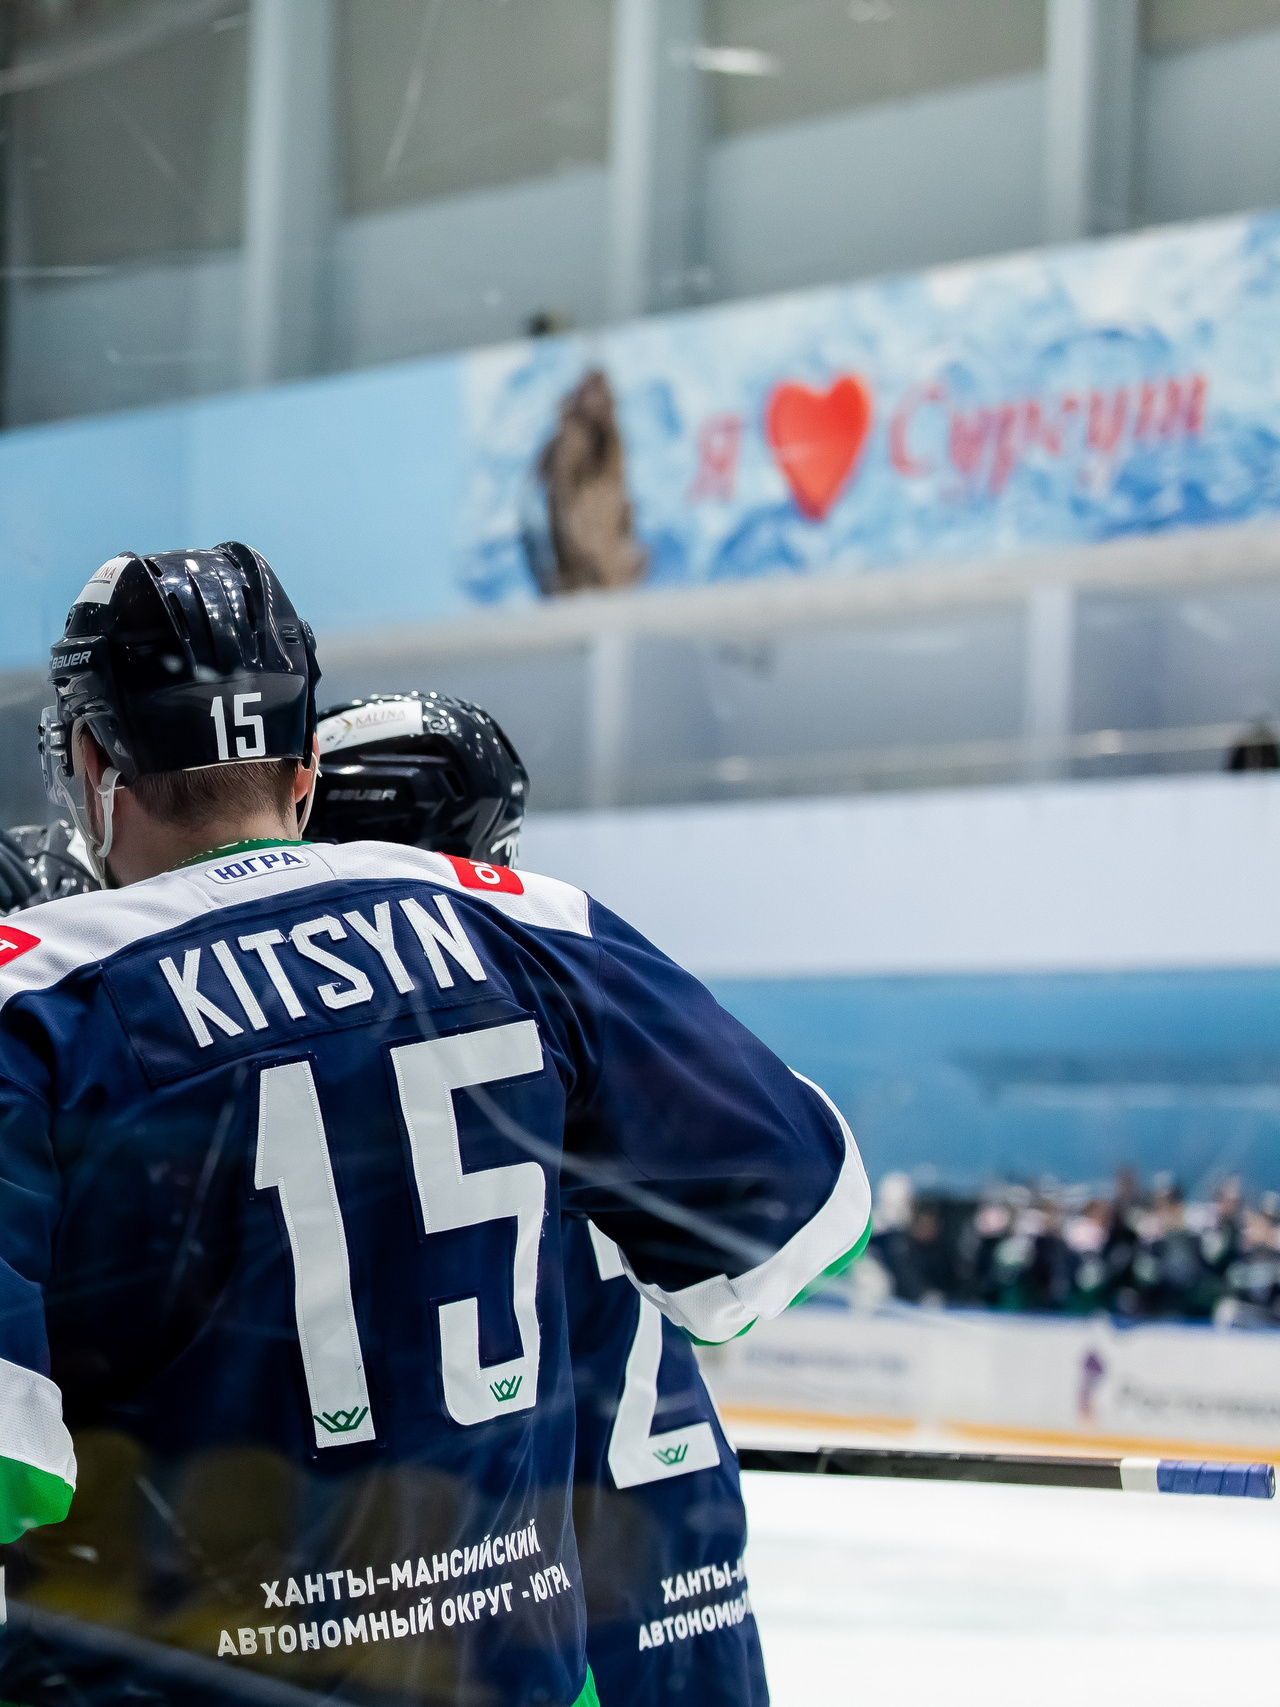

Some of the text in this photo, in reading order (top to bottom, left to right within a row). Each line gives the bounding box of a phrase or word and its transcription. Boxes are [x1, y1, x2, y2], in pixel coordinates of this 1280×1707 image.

[210, 692, 266, 760] 15
[214, 852, 303, 880] ЮГРА
[158, 893, 488, 1048] KITSYN
[254, 1019, 547, 1448] 15
[218, 1597, 434, 1657] АВТОНОМНЫЙ
[440, 1582, 514, 1627] ОКРУГ
[532, 1562, 572, 1604] ЮГРА
[260, 1518, 541, 1609] ХАНТЫ-МАНСИЙСКИЙ
